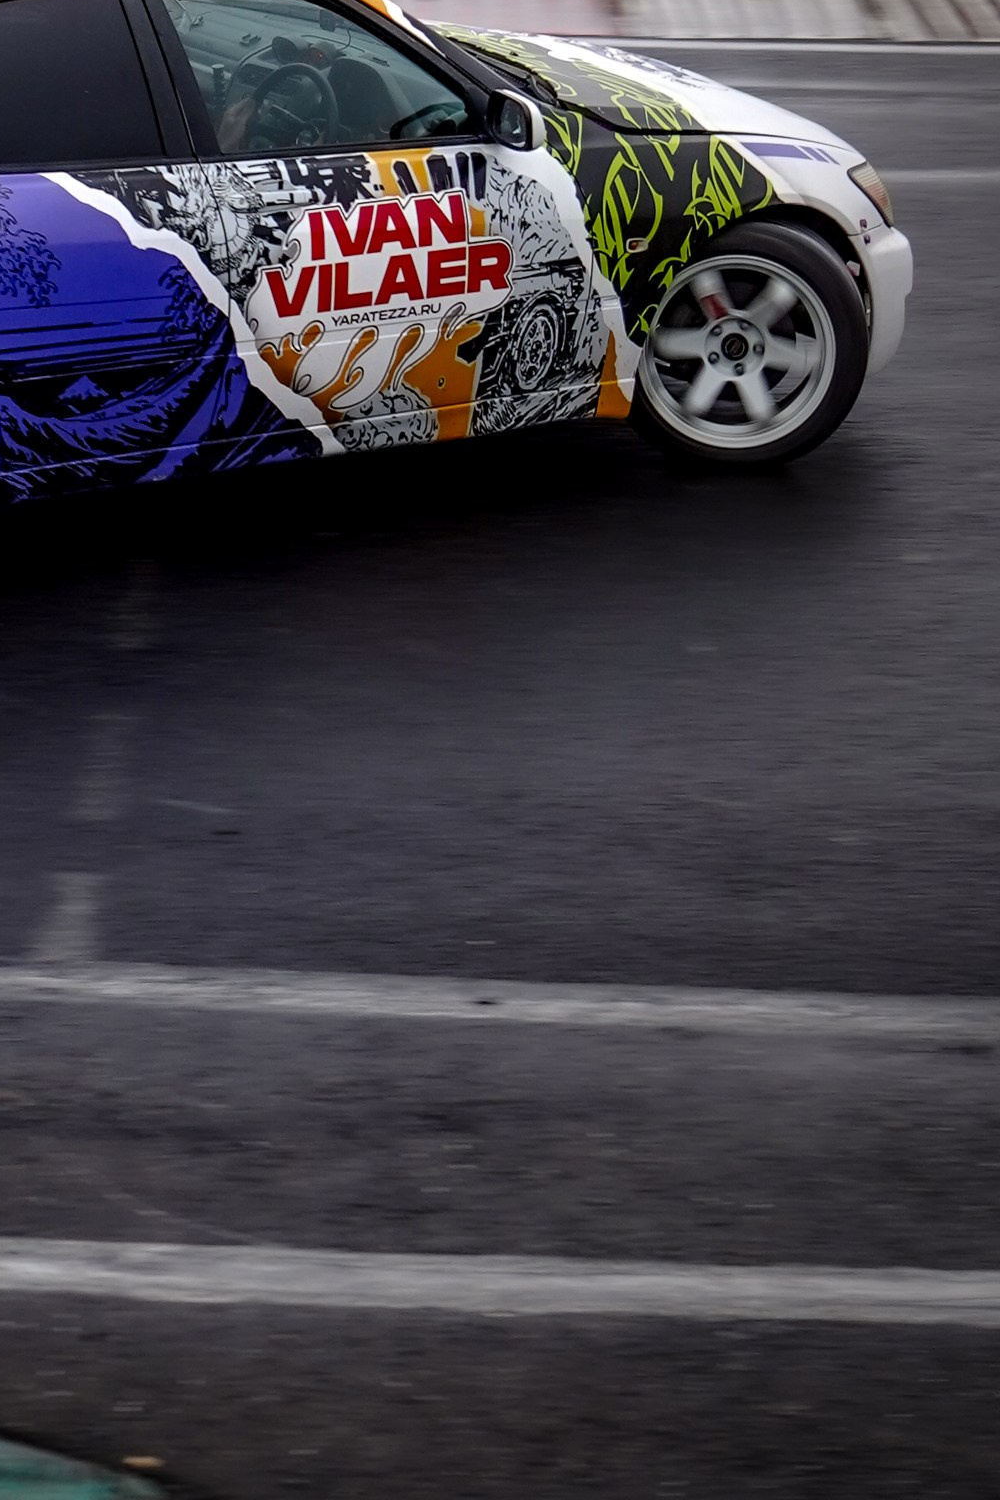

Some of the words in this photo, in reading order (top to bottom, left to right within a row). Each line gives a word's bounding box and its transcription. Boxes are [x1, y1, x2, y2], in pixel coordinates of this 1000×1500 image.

[308, 194, 466, 261] IVAN
[266, 242, 511, 318] VILAER
[331, 303, 442, 327] YARATEZZA.RU
